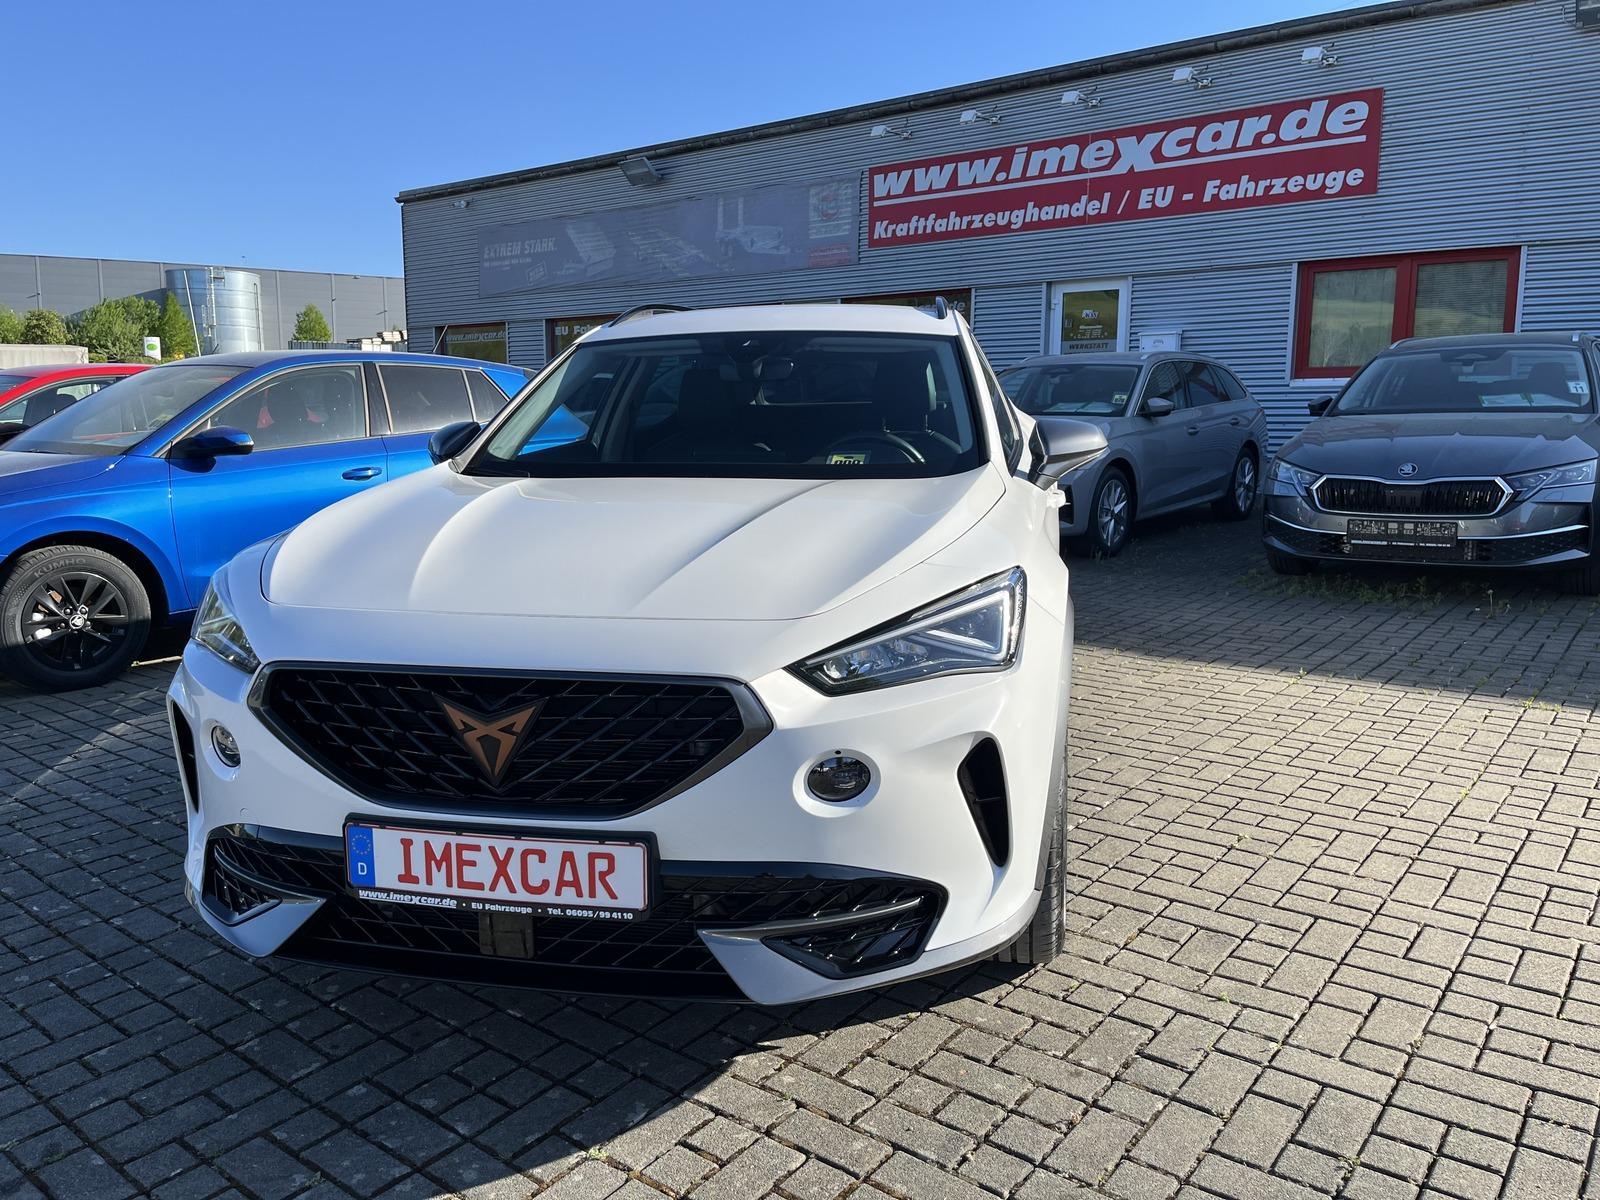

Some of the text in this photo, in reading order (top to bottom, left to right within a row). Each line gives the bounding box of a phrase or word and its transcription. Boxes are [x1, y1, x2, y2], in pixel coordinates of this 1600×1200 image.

[873, 99, 1369, 198] www.imexcar.de
[873, 191, 1111, 239] Kraftfahrzeughandel
[1117, 190, 1130, 214] /
[1137, 185, 1174, 210] EU
[1202, 168, 1364, 203] Fahrzeuge
[483, 241, 522, 260] EXTREM
[555, 326, 568, 336] EU
[34, 558, 86, 577] KUMHO
[357, 862, 367, 876] D
[398, 838, 618, 900] IMEXCAR
[359, 889, 457, 907] www.imexcar.de
[471, 902, 483, 910] EU
[485, 903, 532, 914] Fahrzeuge
[547, 907, 564, 916] Tel.
